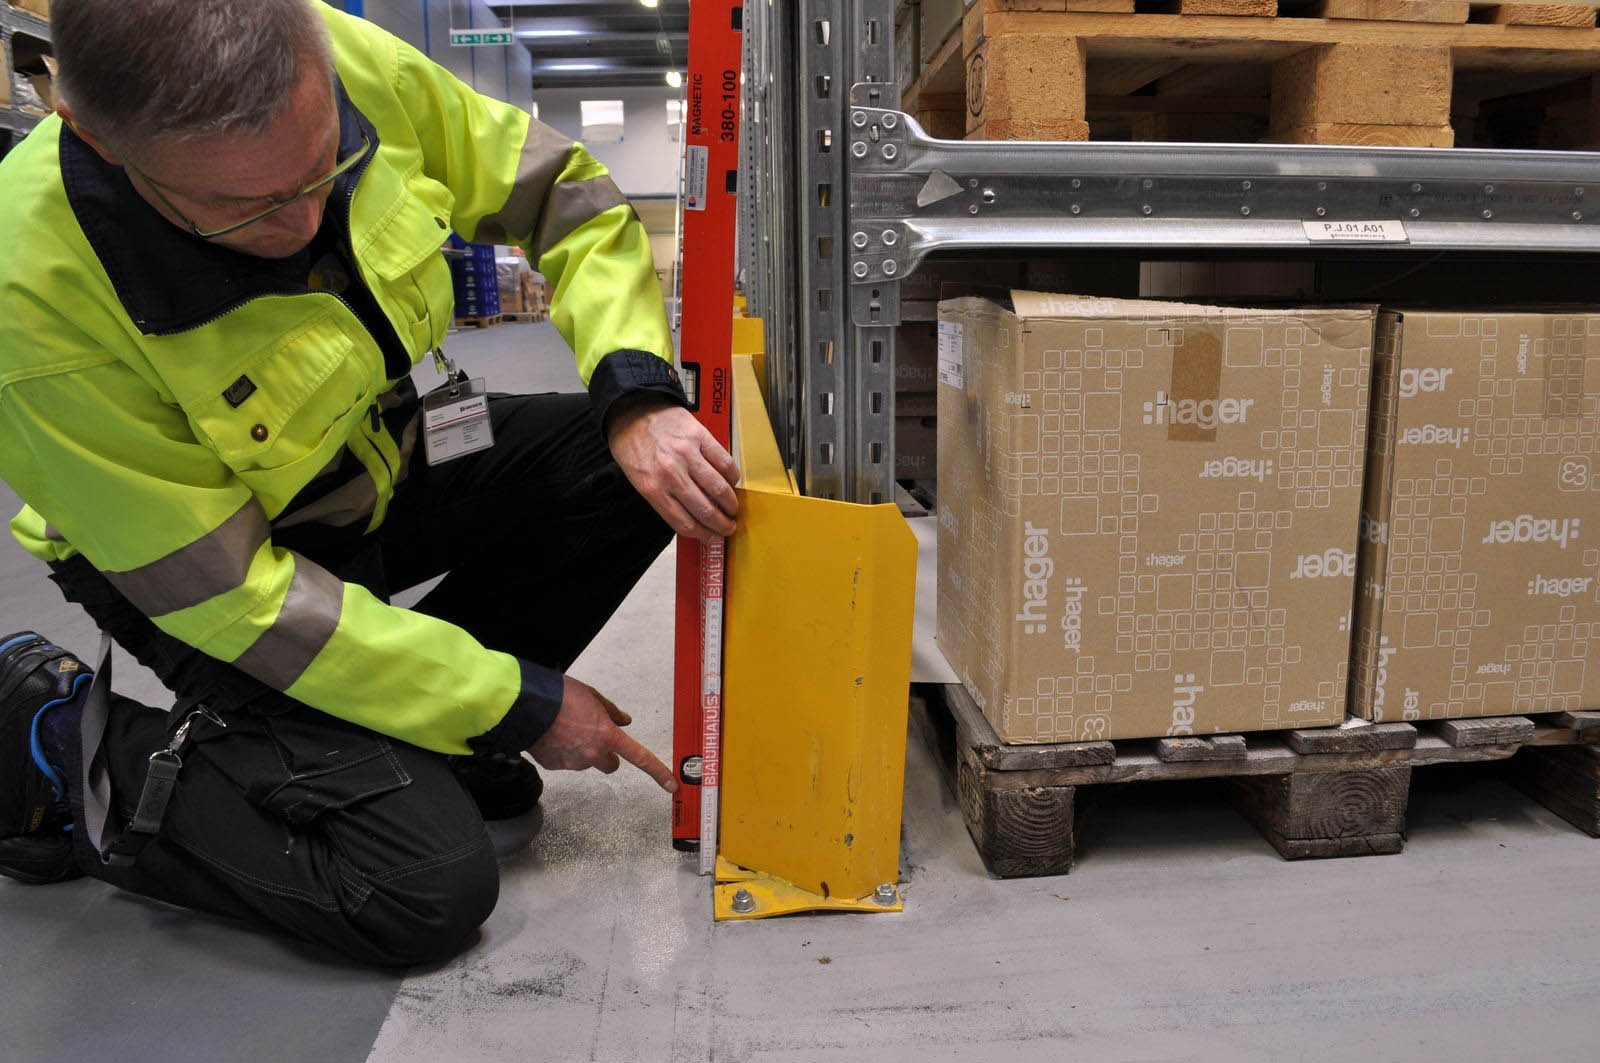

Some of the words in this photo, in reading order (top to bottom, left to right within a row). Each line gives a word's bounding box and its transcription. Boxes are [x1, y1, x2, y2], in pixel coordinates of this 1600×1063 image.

[691, 73, 703, 135] MAGNETIC
[721, 69, 737, 142] 380-100
[1323, 223, 1385, 233] P.J.01.A01
[712, 367, 724, 414] RIDGID
[704, 694, 720, 786] BAUHAUS
